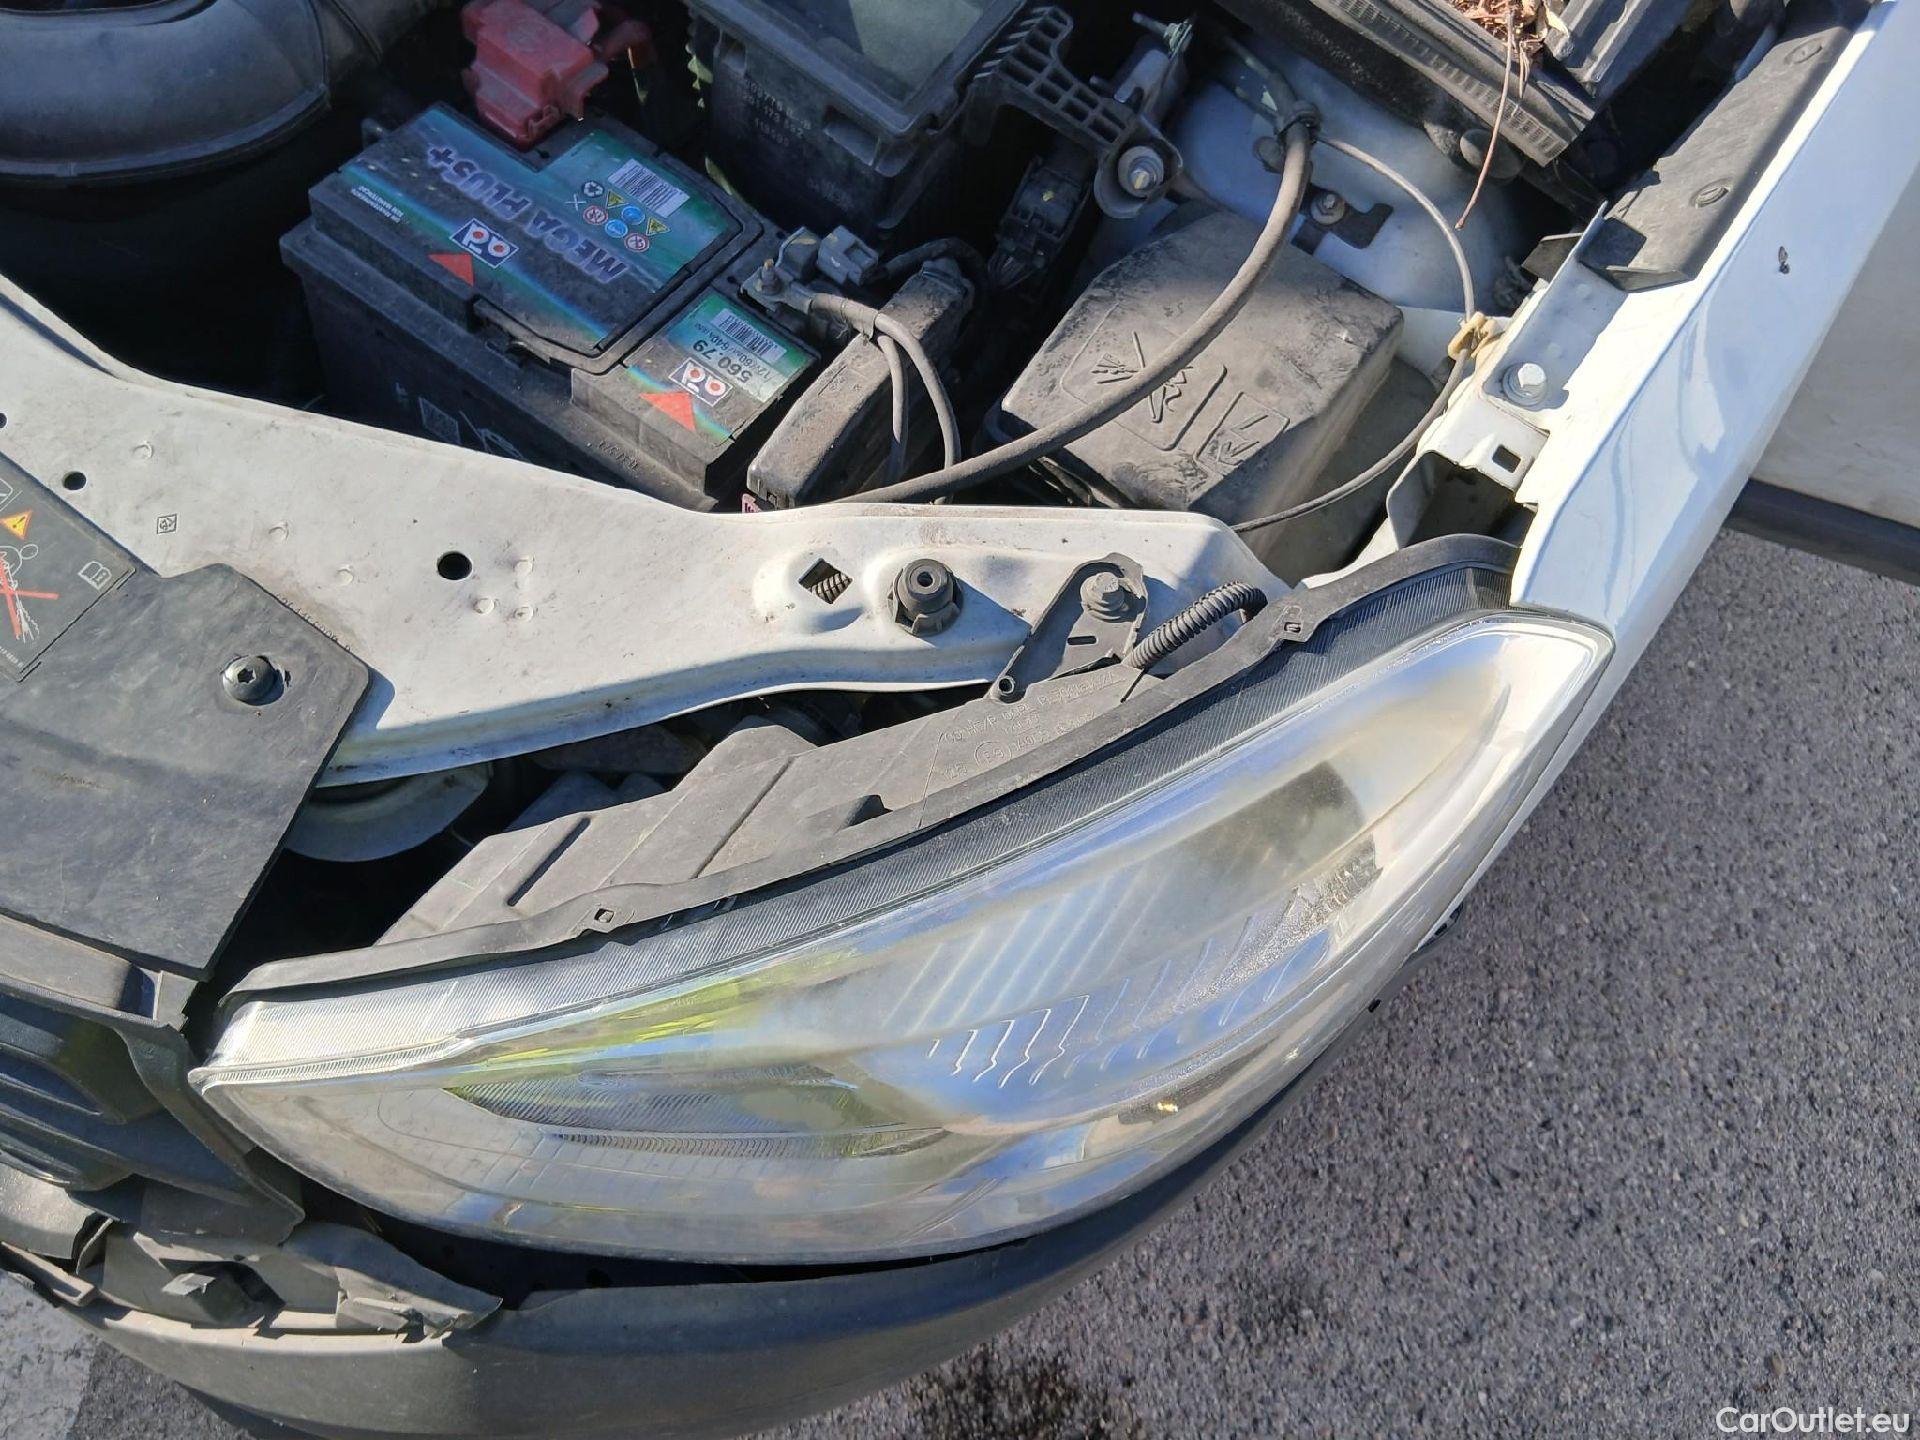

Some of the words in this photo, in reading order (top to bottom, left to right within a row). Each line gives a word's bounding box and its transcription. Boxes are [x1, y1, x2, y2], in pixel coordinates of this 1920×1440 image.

[428, 148, 533, 220] PLUS+
[525, 210, 630, 284] MEGA
[692, 339, 754, 384] 560.79
